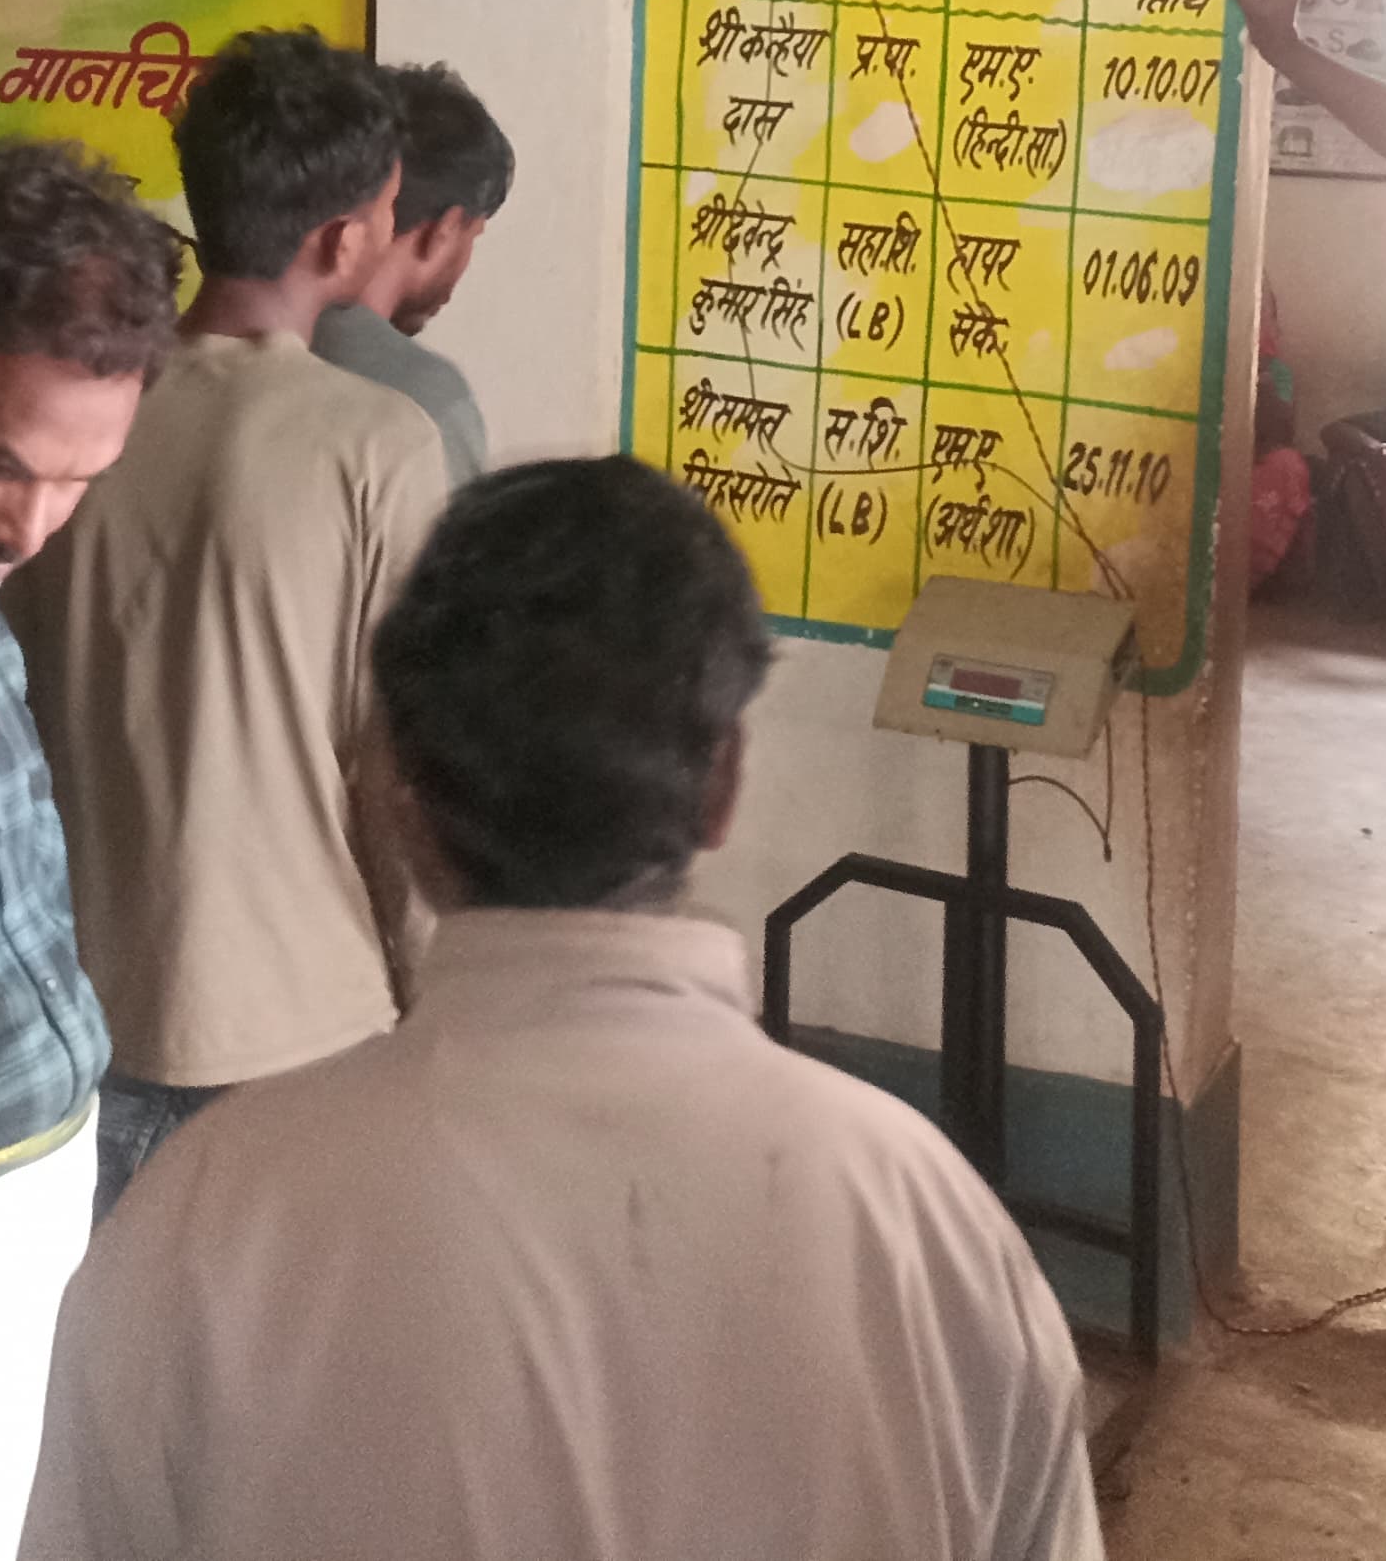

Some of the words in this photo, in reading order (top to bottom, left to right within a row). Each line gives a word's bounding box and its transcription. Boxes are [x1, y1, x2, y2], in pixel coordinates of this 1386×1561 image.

[697, 6, 746, 66] श्री
[740, 12, 830, 77] कन्हैया
[1104, 56, 1221, 106] 10.10.07
[723, 96, 794, 145] दास
[947, 233, 1021, 295] हायर
[1084, 249, 1200, 307] 01.06.09
[690, 278, 767, 335] कुमार
[762, 276, 814, 351] सिंह
[679, 377, 721, 432] श्री
[1064, 442, 1171, 506] 25.11.10
